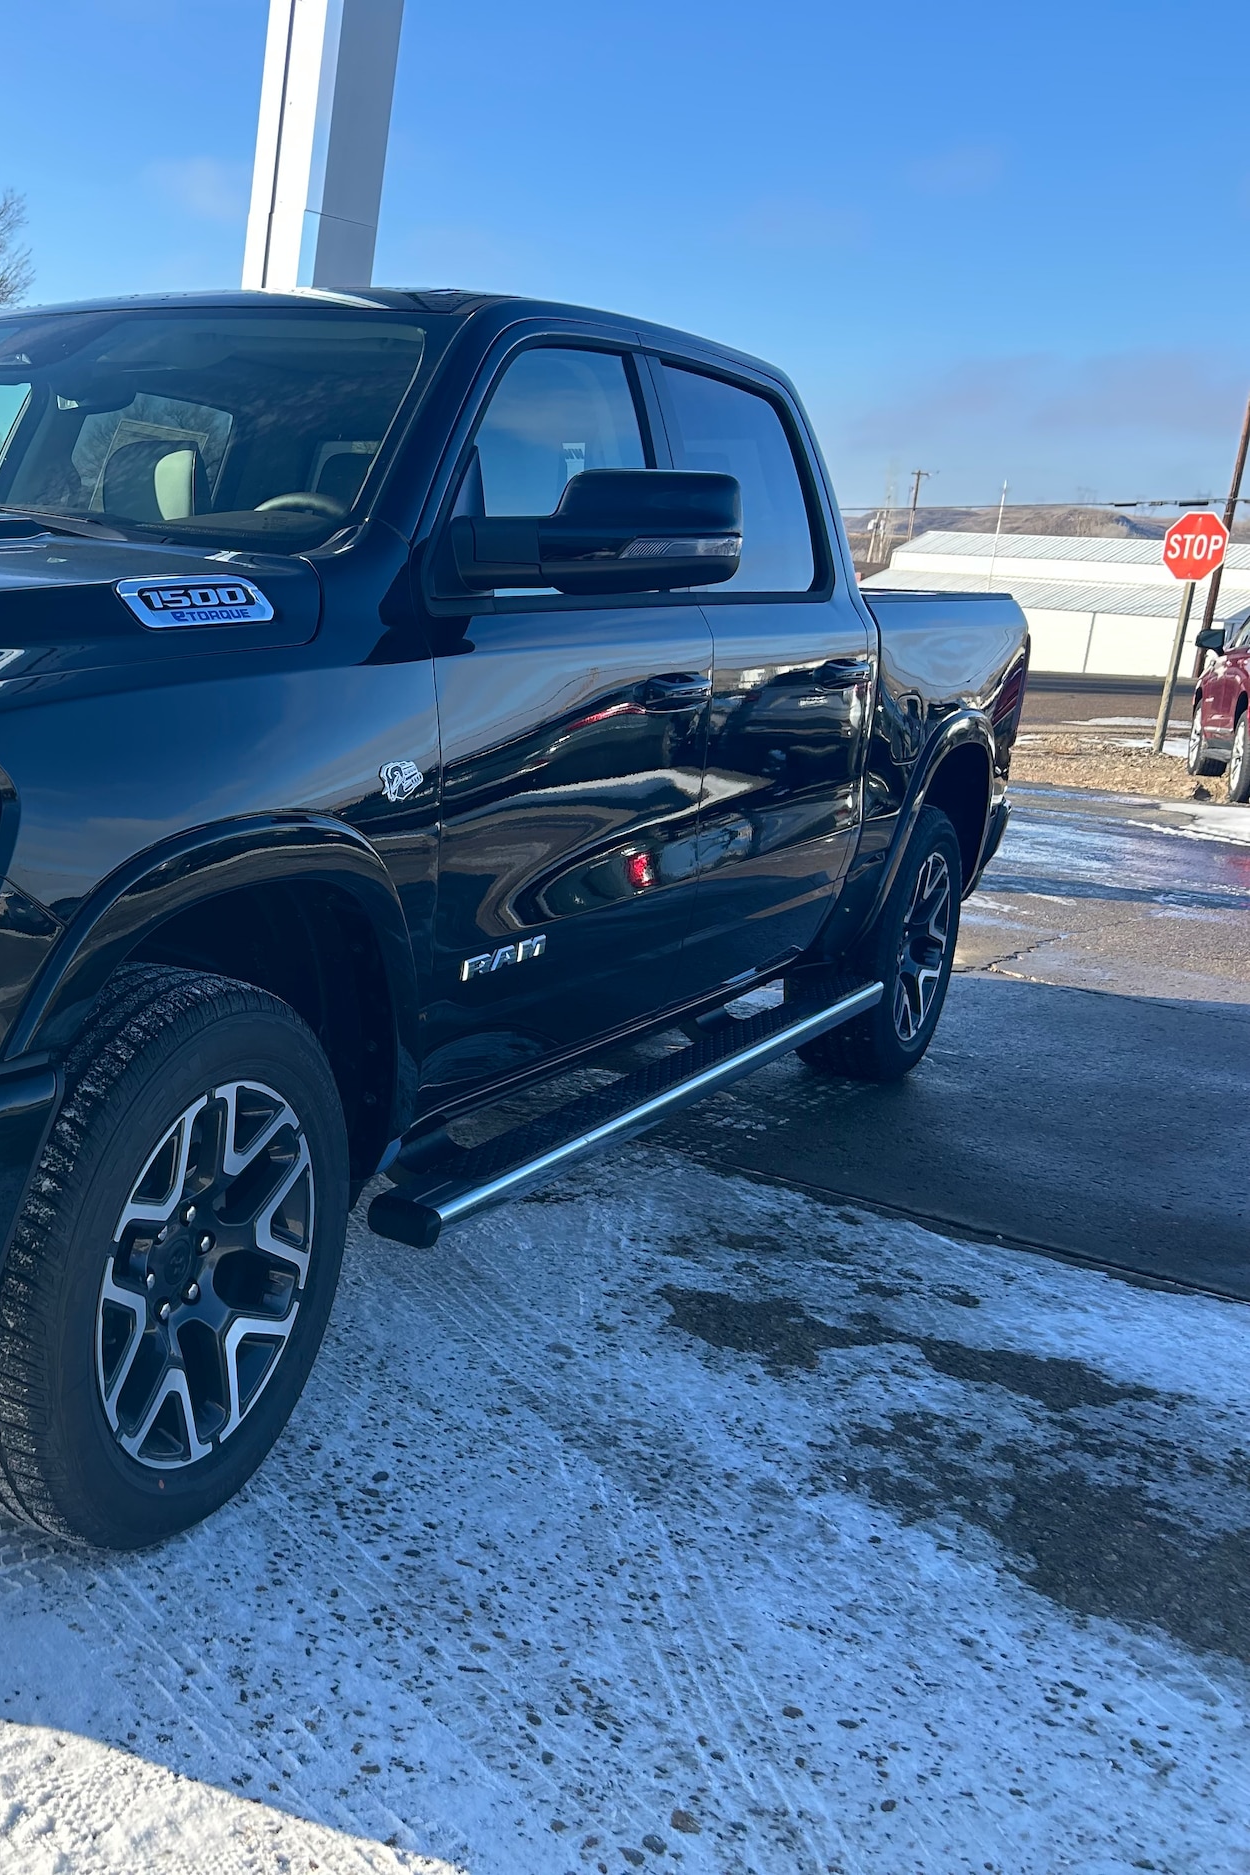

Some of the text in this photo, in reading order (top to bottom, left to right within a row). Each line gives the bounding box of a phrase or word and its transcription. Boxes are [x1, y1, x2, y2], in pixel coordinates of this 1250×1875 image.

[1167, 533, 1224, 560] STOP
[142, 587, 247, 609] 1500
[460, 934, 547, 982] RAM
